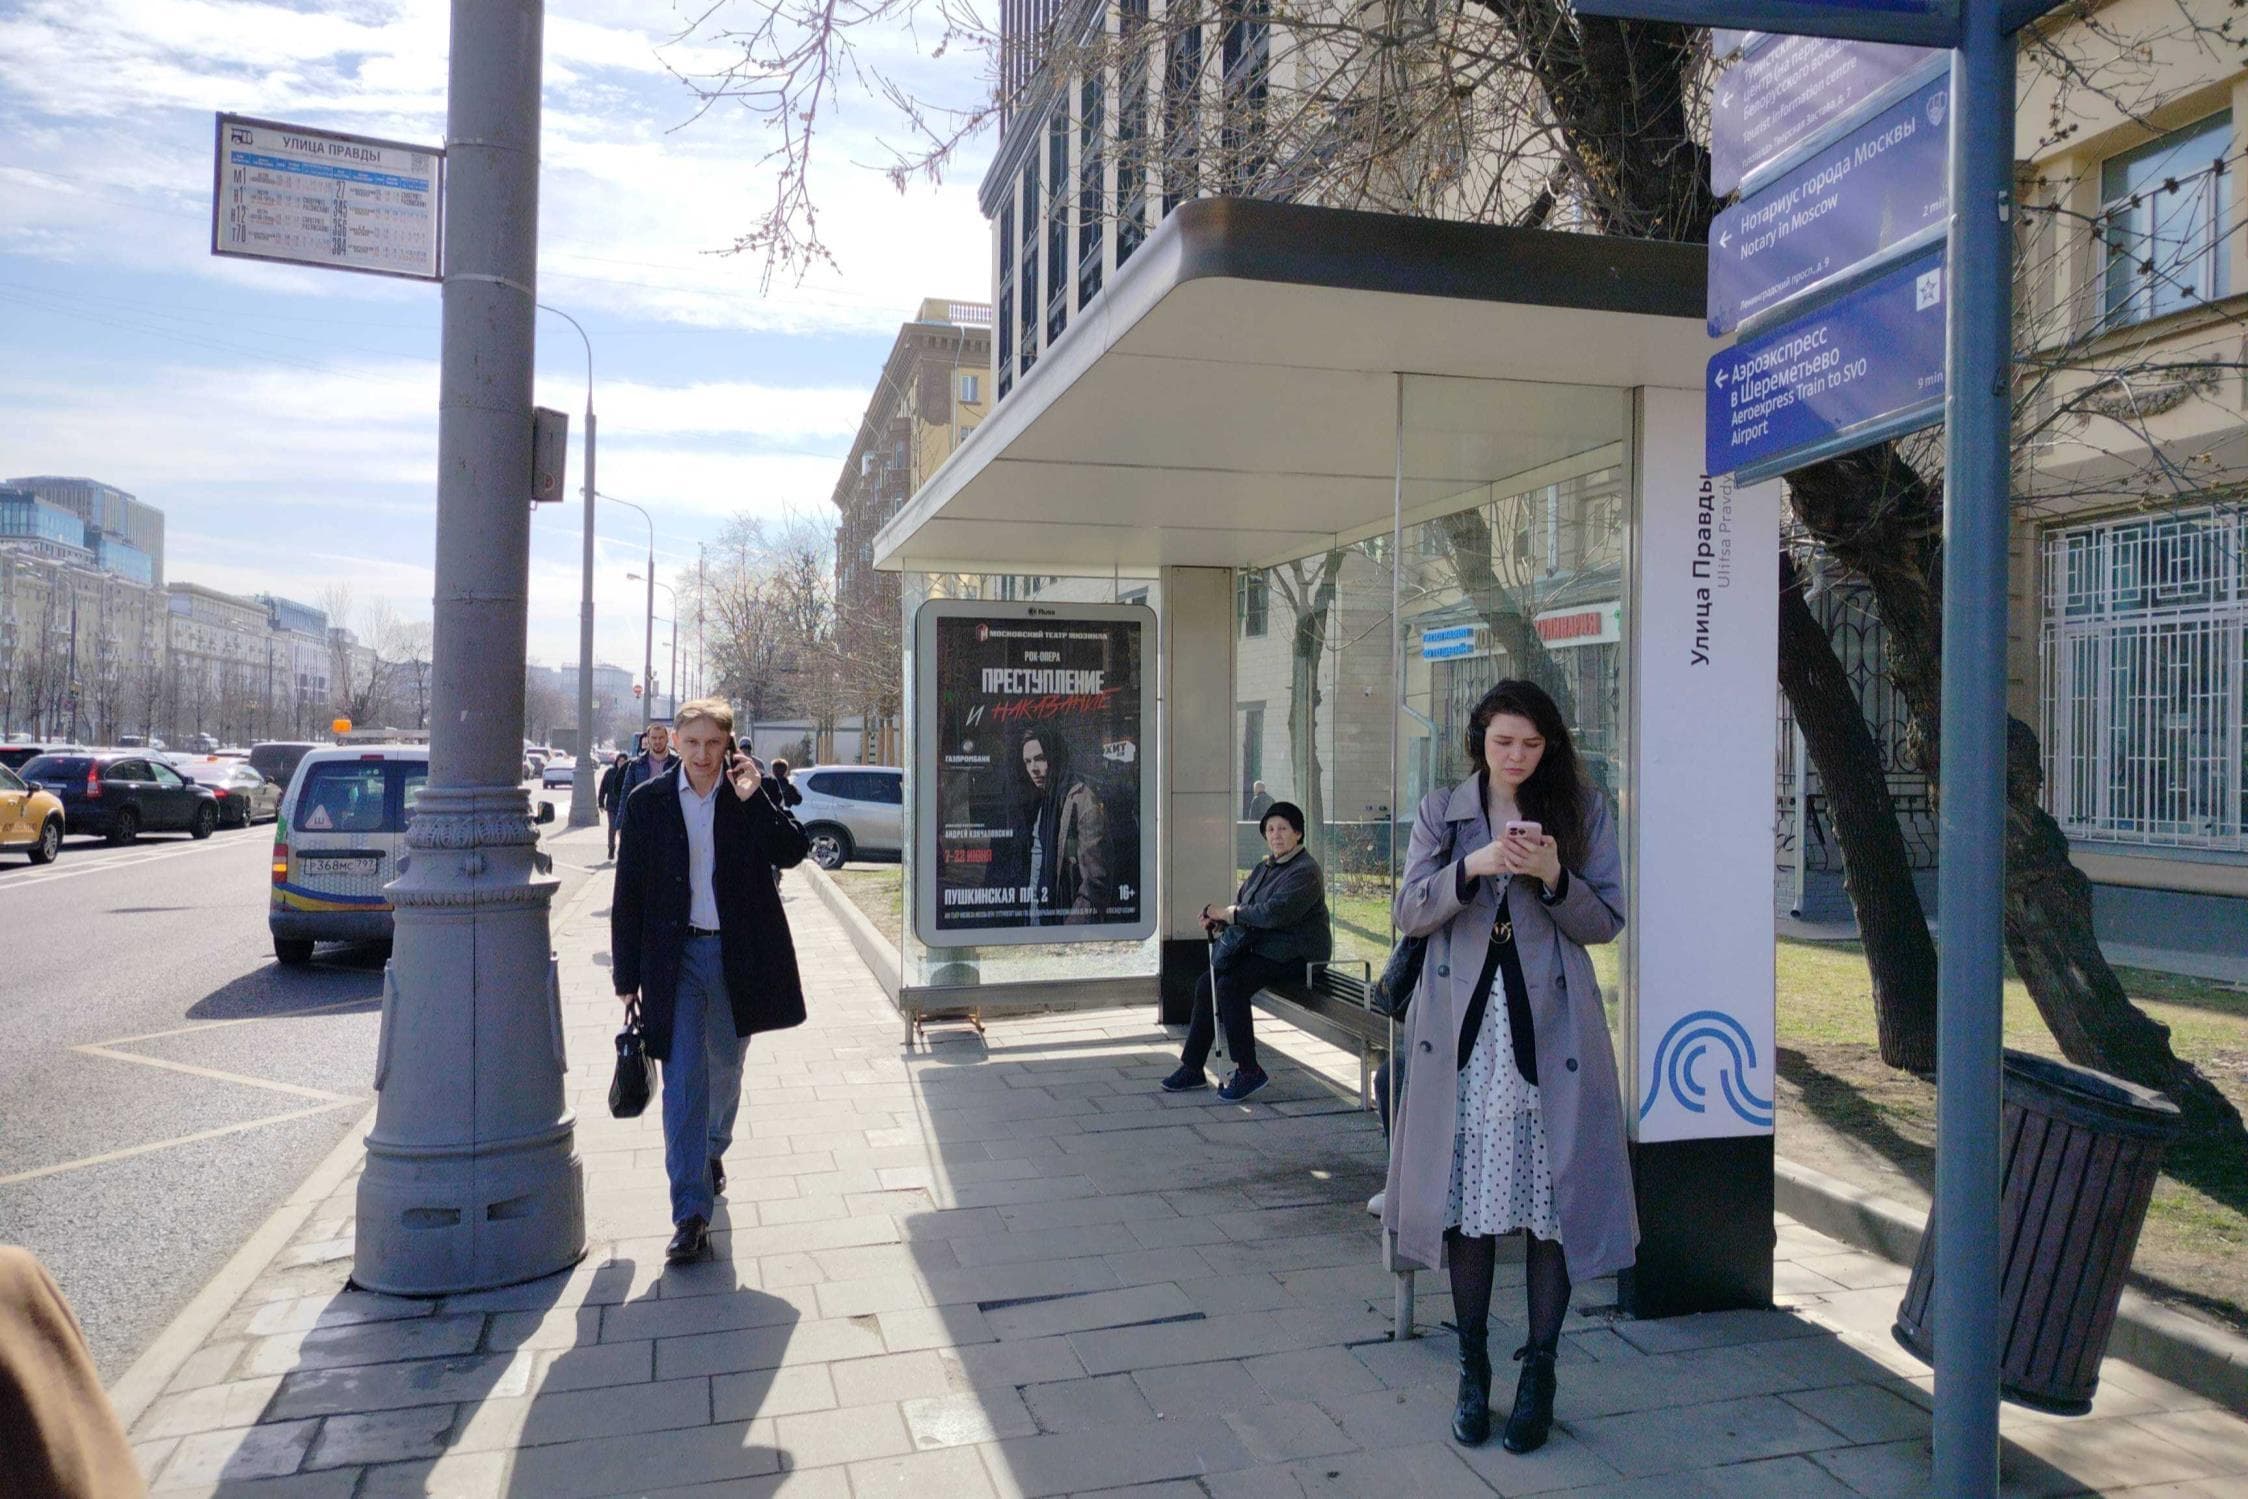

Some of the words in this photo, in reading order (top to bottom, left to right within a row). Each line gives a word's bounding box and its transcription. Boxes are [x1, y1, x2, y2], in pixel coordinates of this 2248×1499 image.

[1743, 116, 1770, 144] Tourist
[1825, 56, 1857, 86] centre
[283, 136, 324, 155] УЛИЦА
[328, 144, 380, 162] ПРАВДЫ
[1741, 186, 1800, 235] Нотариус
[1802, 157, 1850, 203] города
[1853, 116, 1916, 168] Москвы
[332, 218, 347, 237] 356
[333, 199, 347, 218] 345
[1740, 222, 1777, 260] Notary
[1778, 218, 1790, 238] in
[1791, 193, 1839, 232] Moscow
[1731, 326, 1828, 385] Аэроэкспресс
[1731, 391, 1738, 408] в
[1741, 347, 1840, 404] Шереметьево
[1731, 392, 1794, 427] Aeroexpress
[1796, 378, 1825, 407] Train
[1828, 370, 1841, 392] to
[1843, 357, 1867, 383] SVO
[1731, 420, 1768, 447] Airport
[1719, 474, 1735, 533] Pravdy
[1692, 475, 1715, 578] Правды
[1718, 539, 1731, 588] Ulitsa
[1691, 587, 1712, 666] Улица
[1025, 651, 1061, 662] РОК-ОПЕРА
[982, 668, 1105, 694] ПРЕСТУПЛЕНИЕ
[966, 704, 985, 727] И
[992, 687, 1121, 721] НАКАЗАНИЕ
[945, 829, 967, 838] АНДРЕЙ
[944, 887, 1015, 905] ПУШКИНСКАЯ
[1041, 887, 1048, 902] 2
[1118, 884, 1135, 900] 16+
